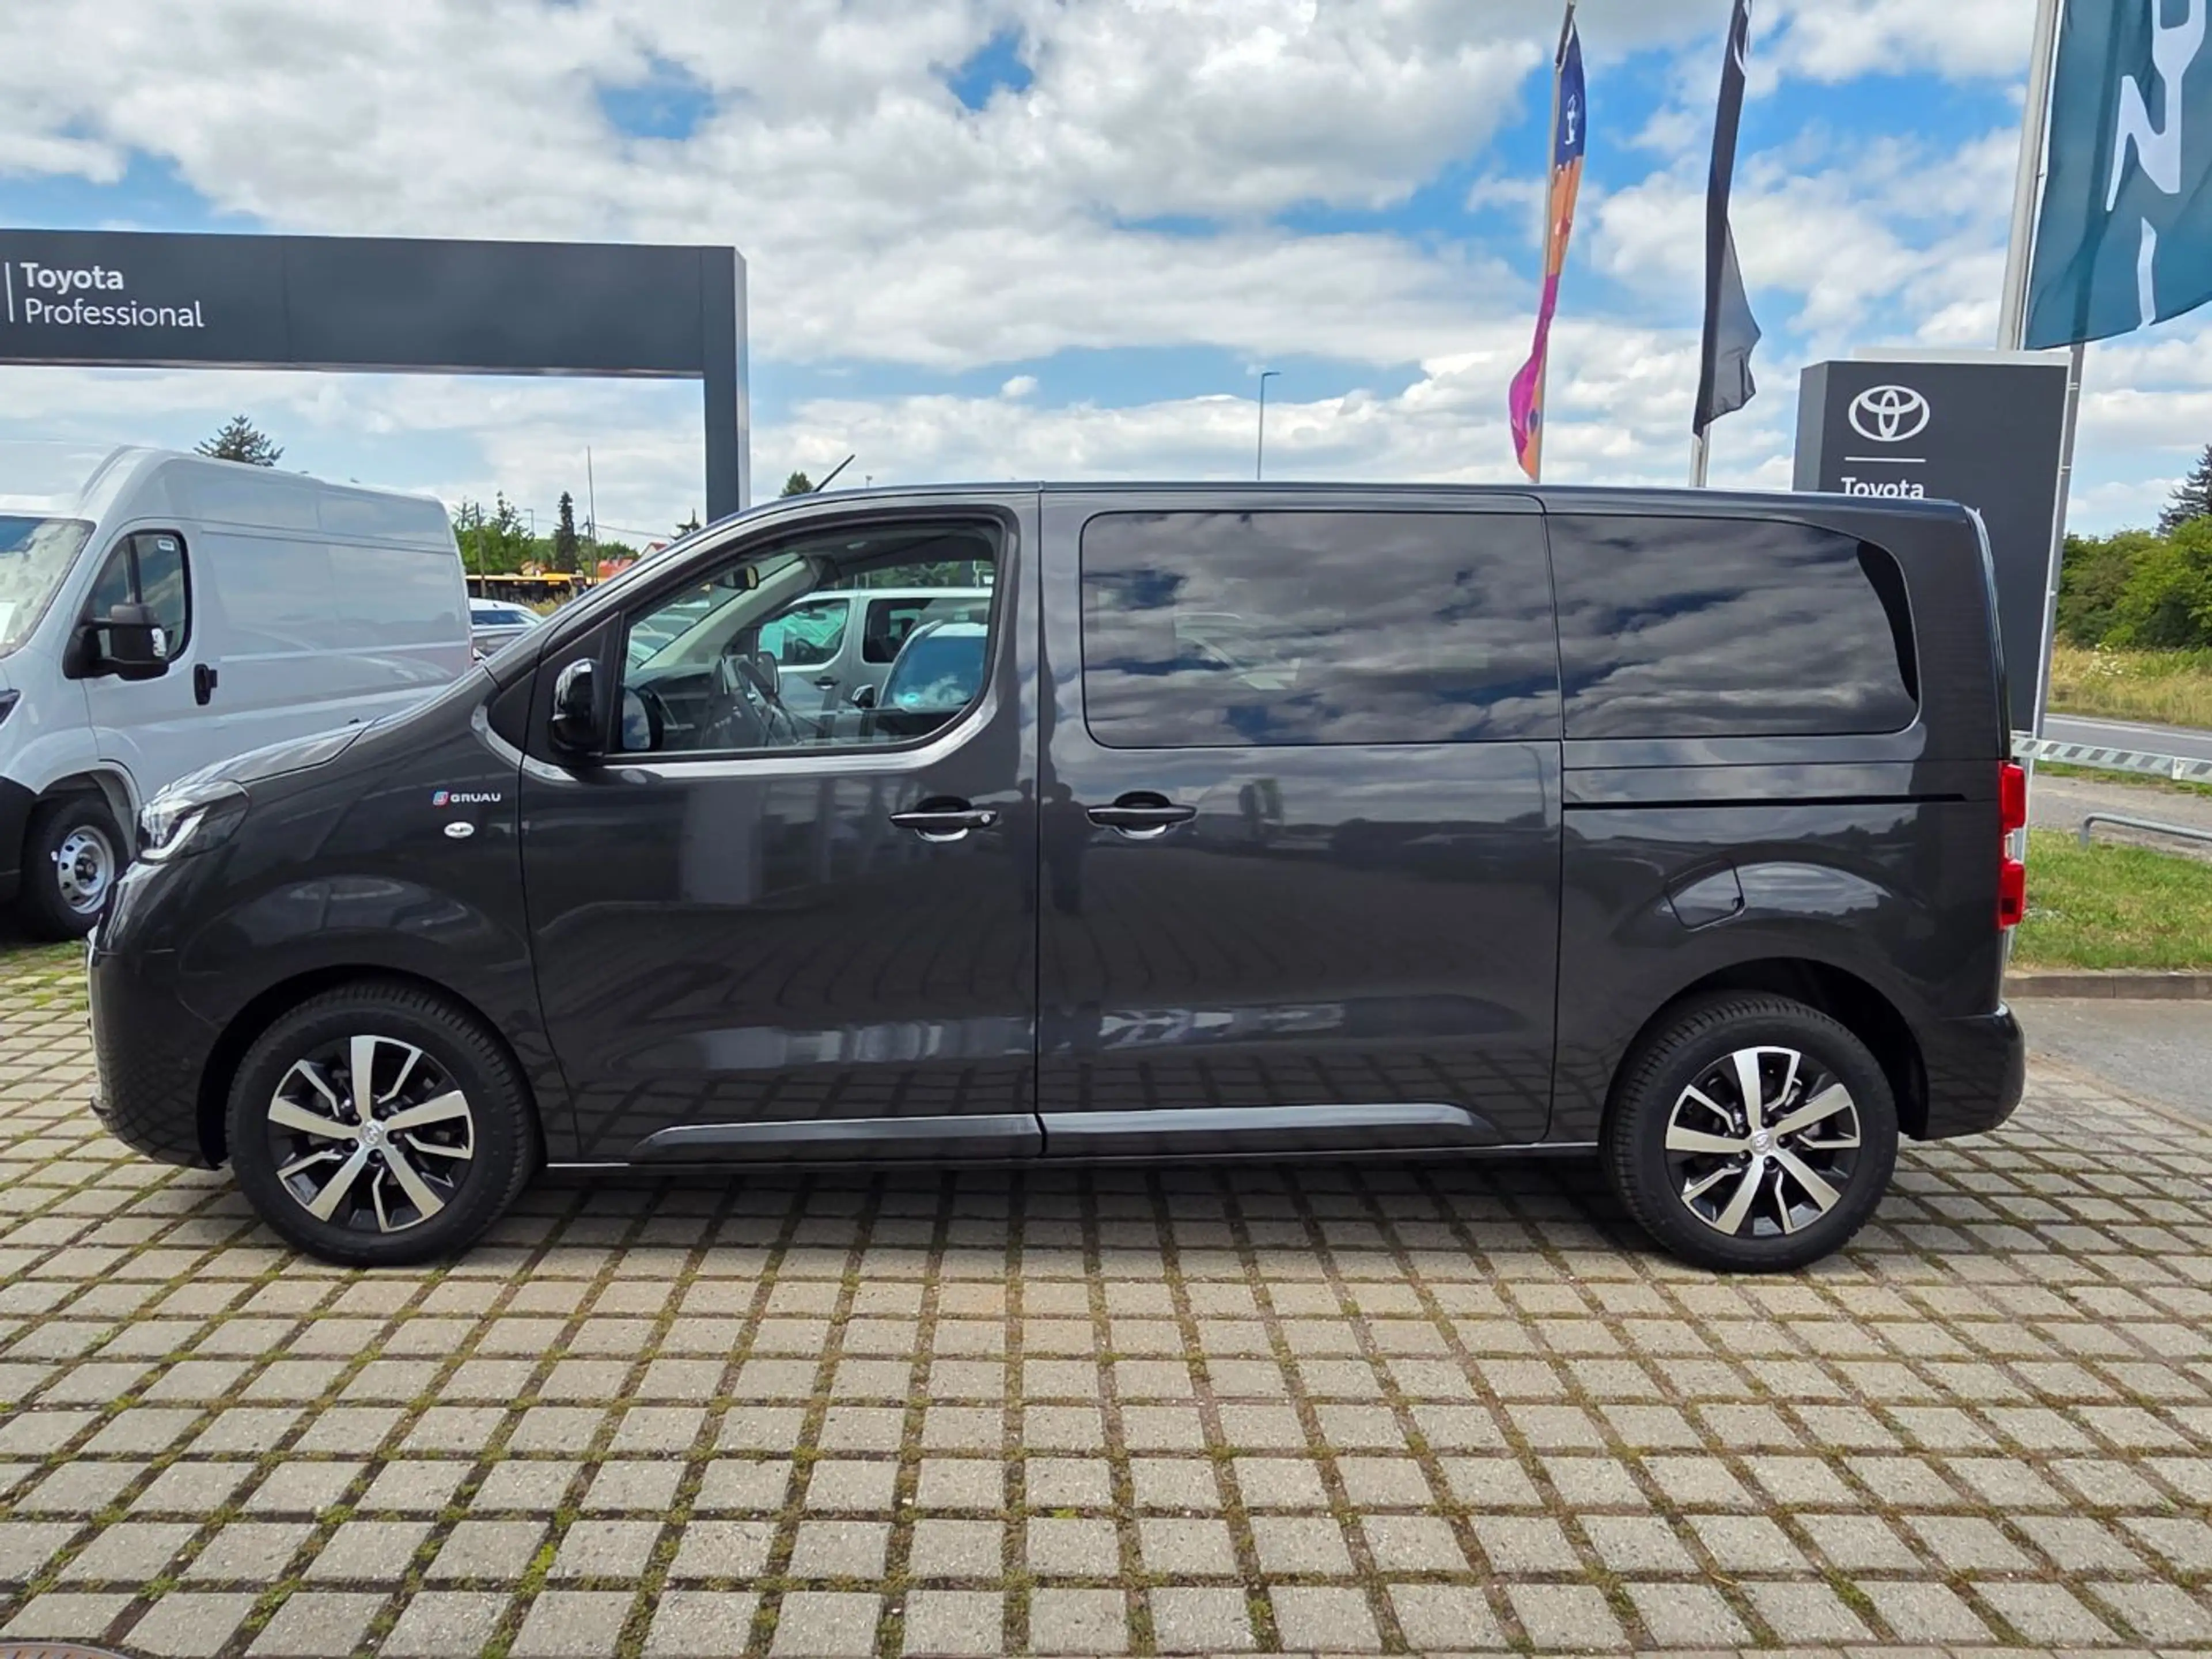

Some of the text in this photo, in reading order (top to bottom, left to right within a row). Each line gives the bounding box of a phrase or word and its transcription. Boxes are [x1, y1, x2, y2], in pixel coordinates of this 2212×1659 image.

[20, 262, 124, 295] Toyota
[25, 298, 205, 328] Professional
[1841, 477, 1925, 499] Toyota
